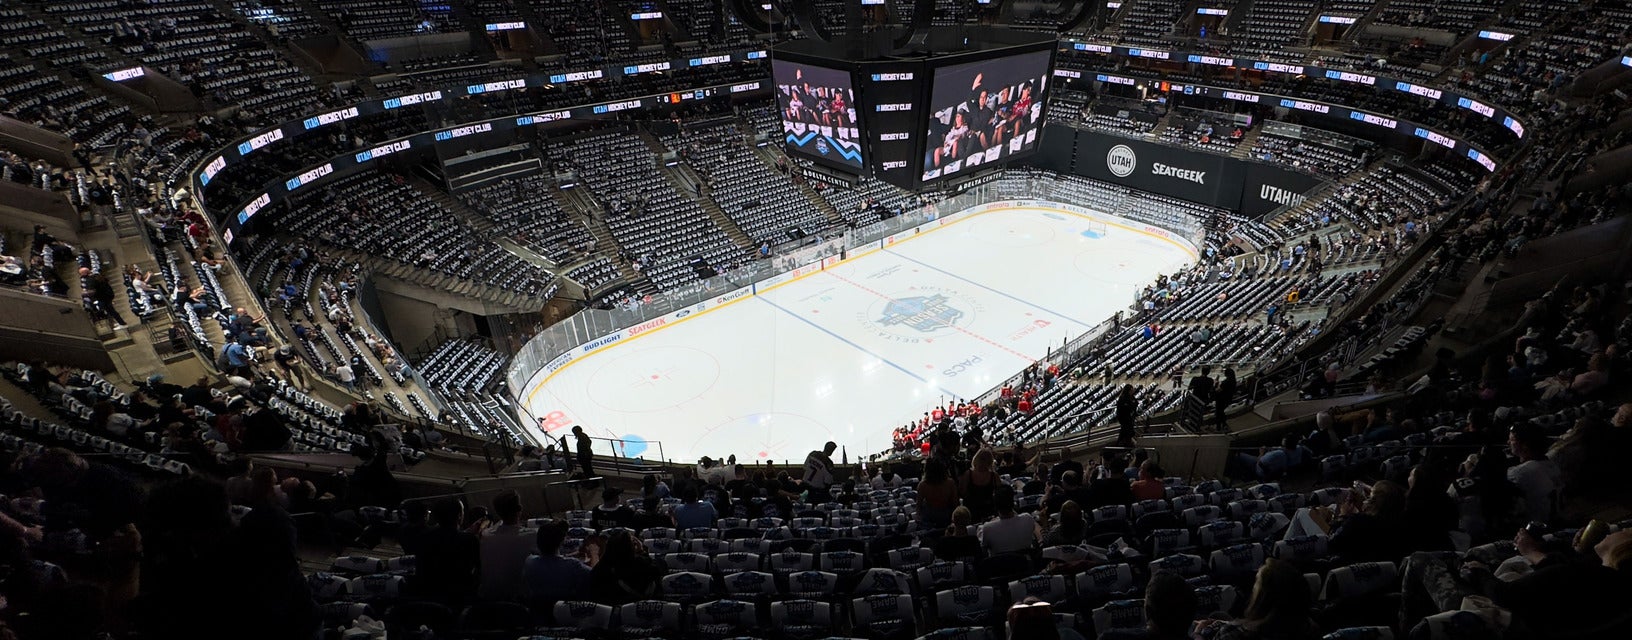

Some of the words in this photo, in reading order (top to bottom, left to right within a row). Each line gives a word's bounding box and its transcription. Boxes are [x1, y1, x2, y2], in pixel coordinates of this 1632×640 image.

[624, 66, 638, 74] UTAH
[638, 62, 658, 72] HOCKEY
[657, 62, 670, 70] CLUB
[1254, 62, 1268, 70] UTAH
[1268, 63, 1290, 72] HOCKEY
[1288, 66, 1304, 74] CLUB
[550, 74, 566, 84] UTAH
[566, 71, 589, 82] HOCKEY
[588, 70, 602, 79] CLUB
[900, 72, 914, 80] CLUB
[1326, 70, 1341, 79] UTAH
[1340, 72, 1362, 82] HOCKEY
[1360, 75, 1376, 85] CLUB
[467, 84, 485, 94] UTAH
[484, 81, 509, 92] HOCKEY
[508, 79, 526, 89] CLUB
[383, 98, 400, 110] UTAH
[400, 93, 425, 106] HOCKEY
[424, 91, 442, 102] CLUB
[593, 104, 608, 114] UTAH
[608, 102, 629, 112] HOCKEY
[628, 100, 642, 108] CLUB
[880, 104, 899, 112] HOCKEY
[1280, 99, 1295, 108] UTAH
[1294, 101, 1316, 112] HOCKEY
[1314, 104, 1330, 114] CLUB
[304, 117, 319, 130] UTAH
[318, 110, 343, 126] HOCKEY
[342, 107, 359, 120] CLUB
[517, 116, 534, 126] UTAH
[532, 113, 556, 124] HOCKEY
[555, 111, 571, 120] CLUB
[435, 130, 452, 141] UTAH
[451, 126, 476, 138] HOCKEY
[474, 123, 492, 134] CLUB
[356, 150, 372, 163] UTAH
[370, 144, 395, 158] HOCKEY
[394, 140, 411, 151] CLUB
[1112, 155, 1131, 168] UTAH
[286, 177, 301, 190] UTAH
[299, 169, 320, 186] HOCKEY
[318, 163, 334, 178] CLUB
[808, 170, 828, 183] DELTA
[826, 176, 850, 188] CENTER
[962, 178, 982, 188] DELTA
[982, 172, 1002, 184] CENTER
[1152, 162, 1206, 184] SEATGEEK
[1260, 184, 1292, 206] UTAH
[722, 293, 734, 302] Ken
[628, 316, 666, 336] SEATGEEK
[584, 341, 600, 352] BUD
[600, 334, 622, 346] LIGHT
[546, 352, 571, 370] AMERICAN
[942, 354, 983, 378] PACS
[954, 588, 978, 597] GAME
[637, 602, 663, 612] GAME
[788, 602, 812, 612] GAME
[872, 597, 897, 608] GAME
[1111, 606, 1141, 620] GAME
